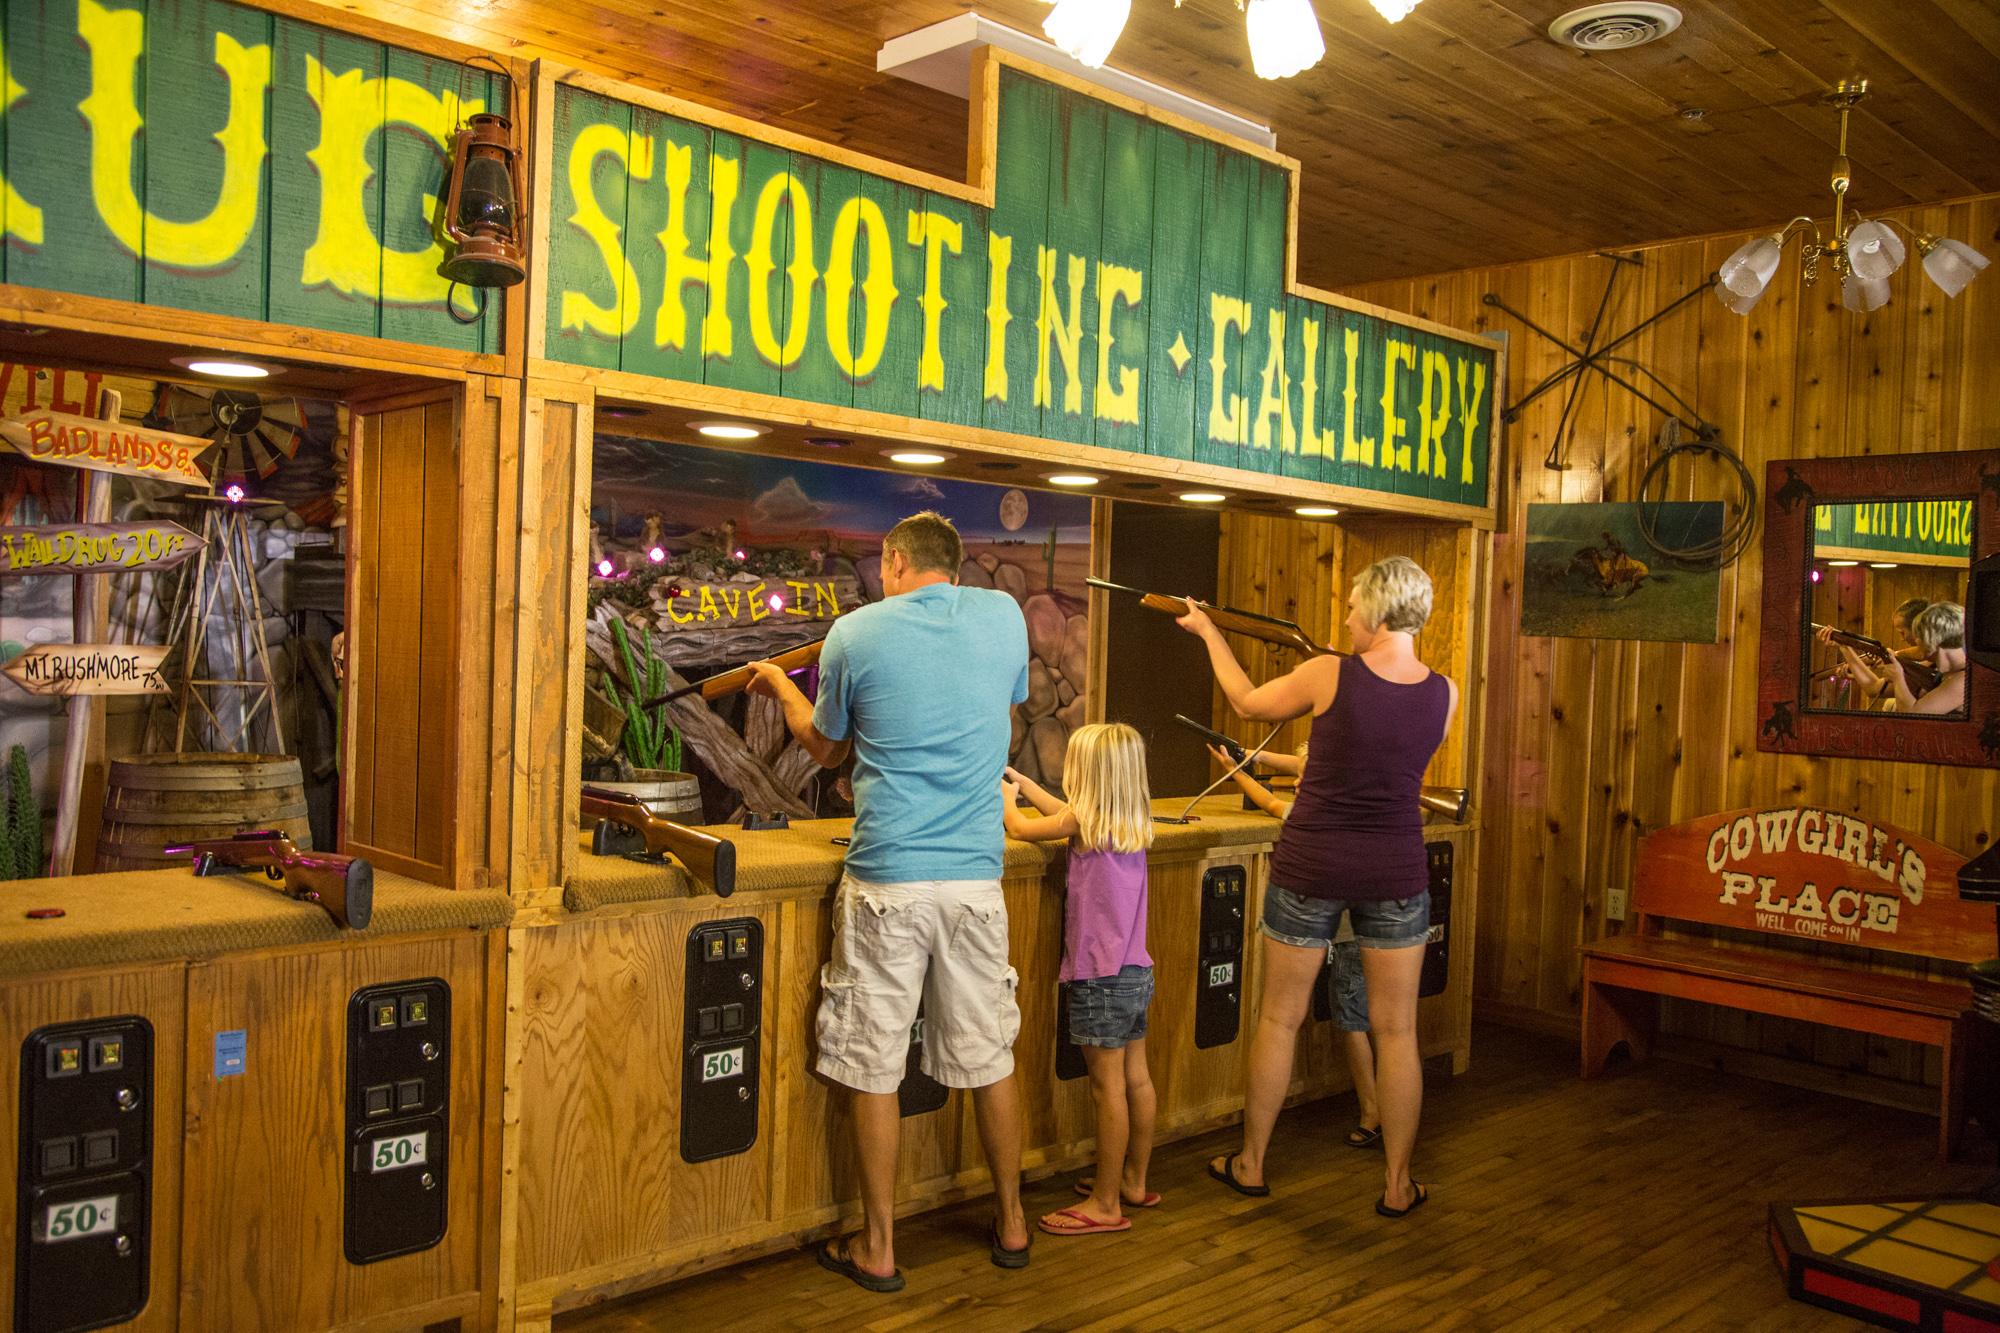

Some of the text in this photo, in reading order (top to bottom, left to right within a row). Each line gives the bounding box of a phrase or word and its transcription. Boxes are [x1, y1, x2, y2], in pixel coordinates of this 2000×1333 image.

[0, 0, 487, 315] UG
[561, 122, 1486, 485] SHOOTING GALLERY
[26, 417, 174, 473] BADLANDS
[175, 447, 189, 469] 8
[124, 528, 163, 568] 20
[667, 580, 841, 624] CAVE IN
[51, 653, 140, 682] RUSHMORE
[142, 670, 159, 688] 75
[1705, 809, 1927, 906] COWGIRL'S
[1719, 871, 1901, 934] PLACE
[1845, 927, 1861, 942] IN
[376, 1139, 422, 1167] 50¢
[51, 1203, 112, 1237] 50¢
